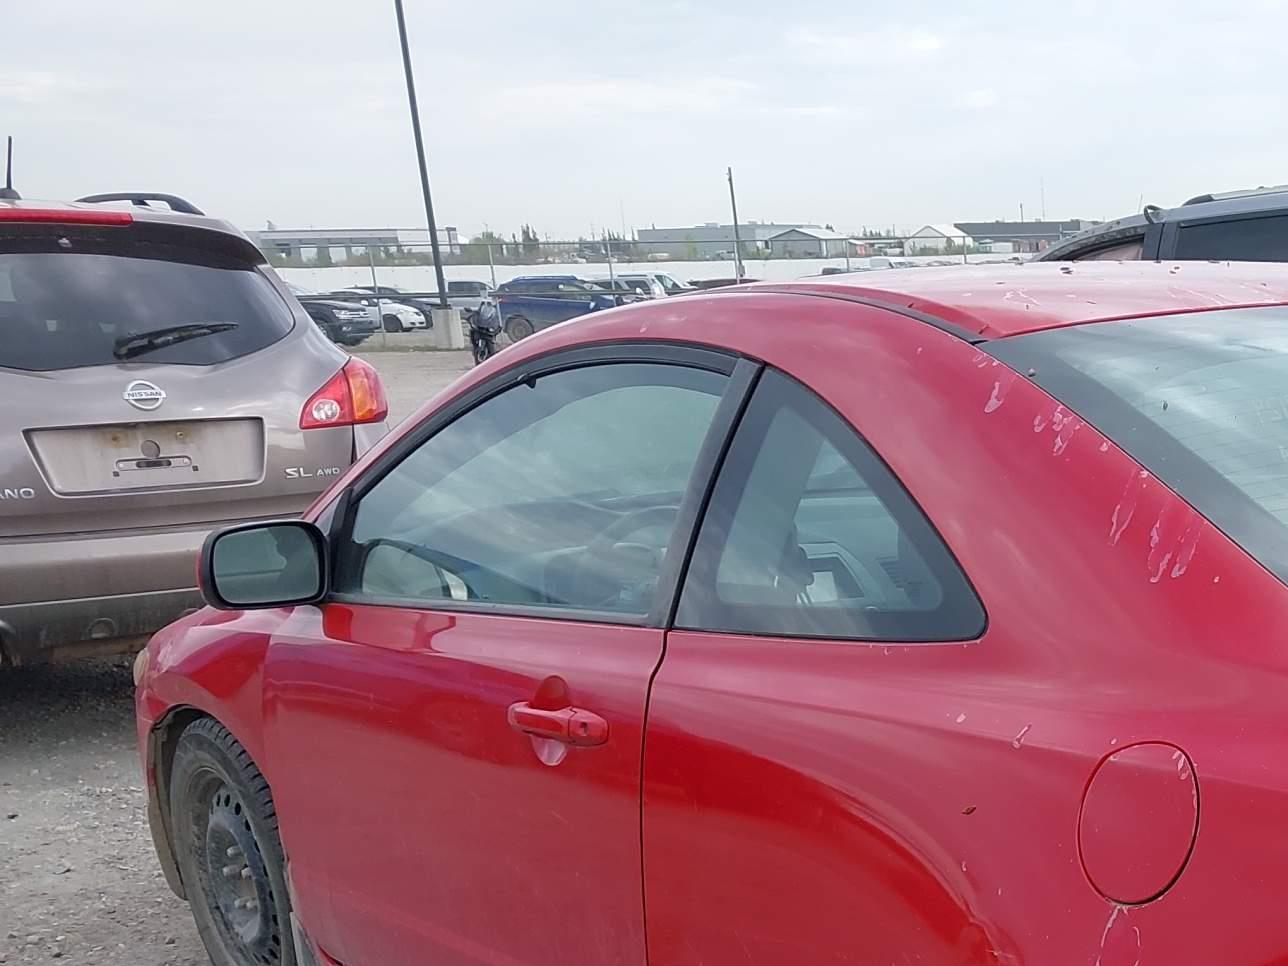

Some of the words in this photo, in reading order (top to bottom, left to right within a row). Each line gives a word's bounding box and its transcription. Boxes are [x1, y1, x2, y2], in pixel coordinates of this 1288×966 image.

[127, 390, 162, 398] NISSAN
[285, 467, 312, 479] SL
[316, 467, 341, 477] AWD
